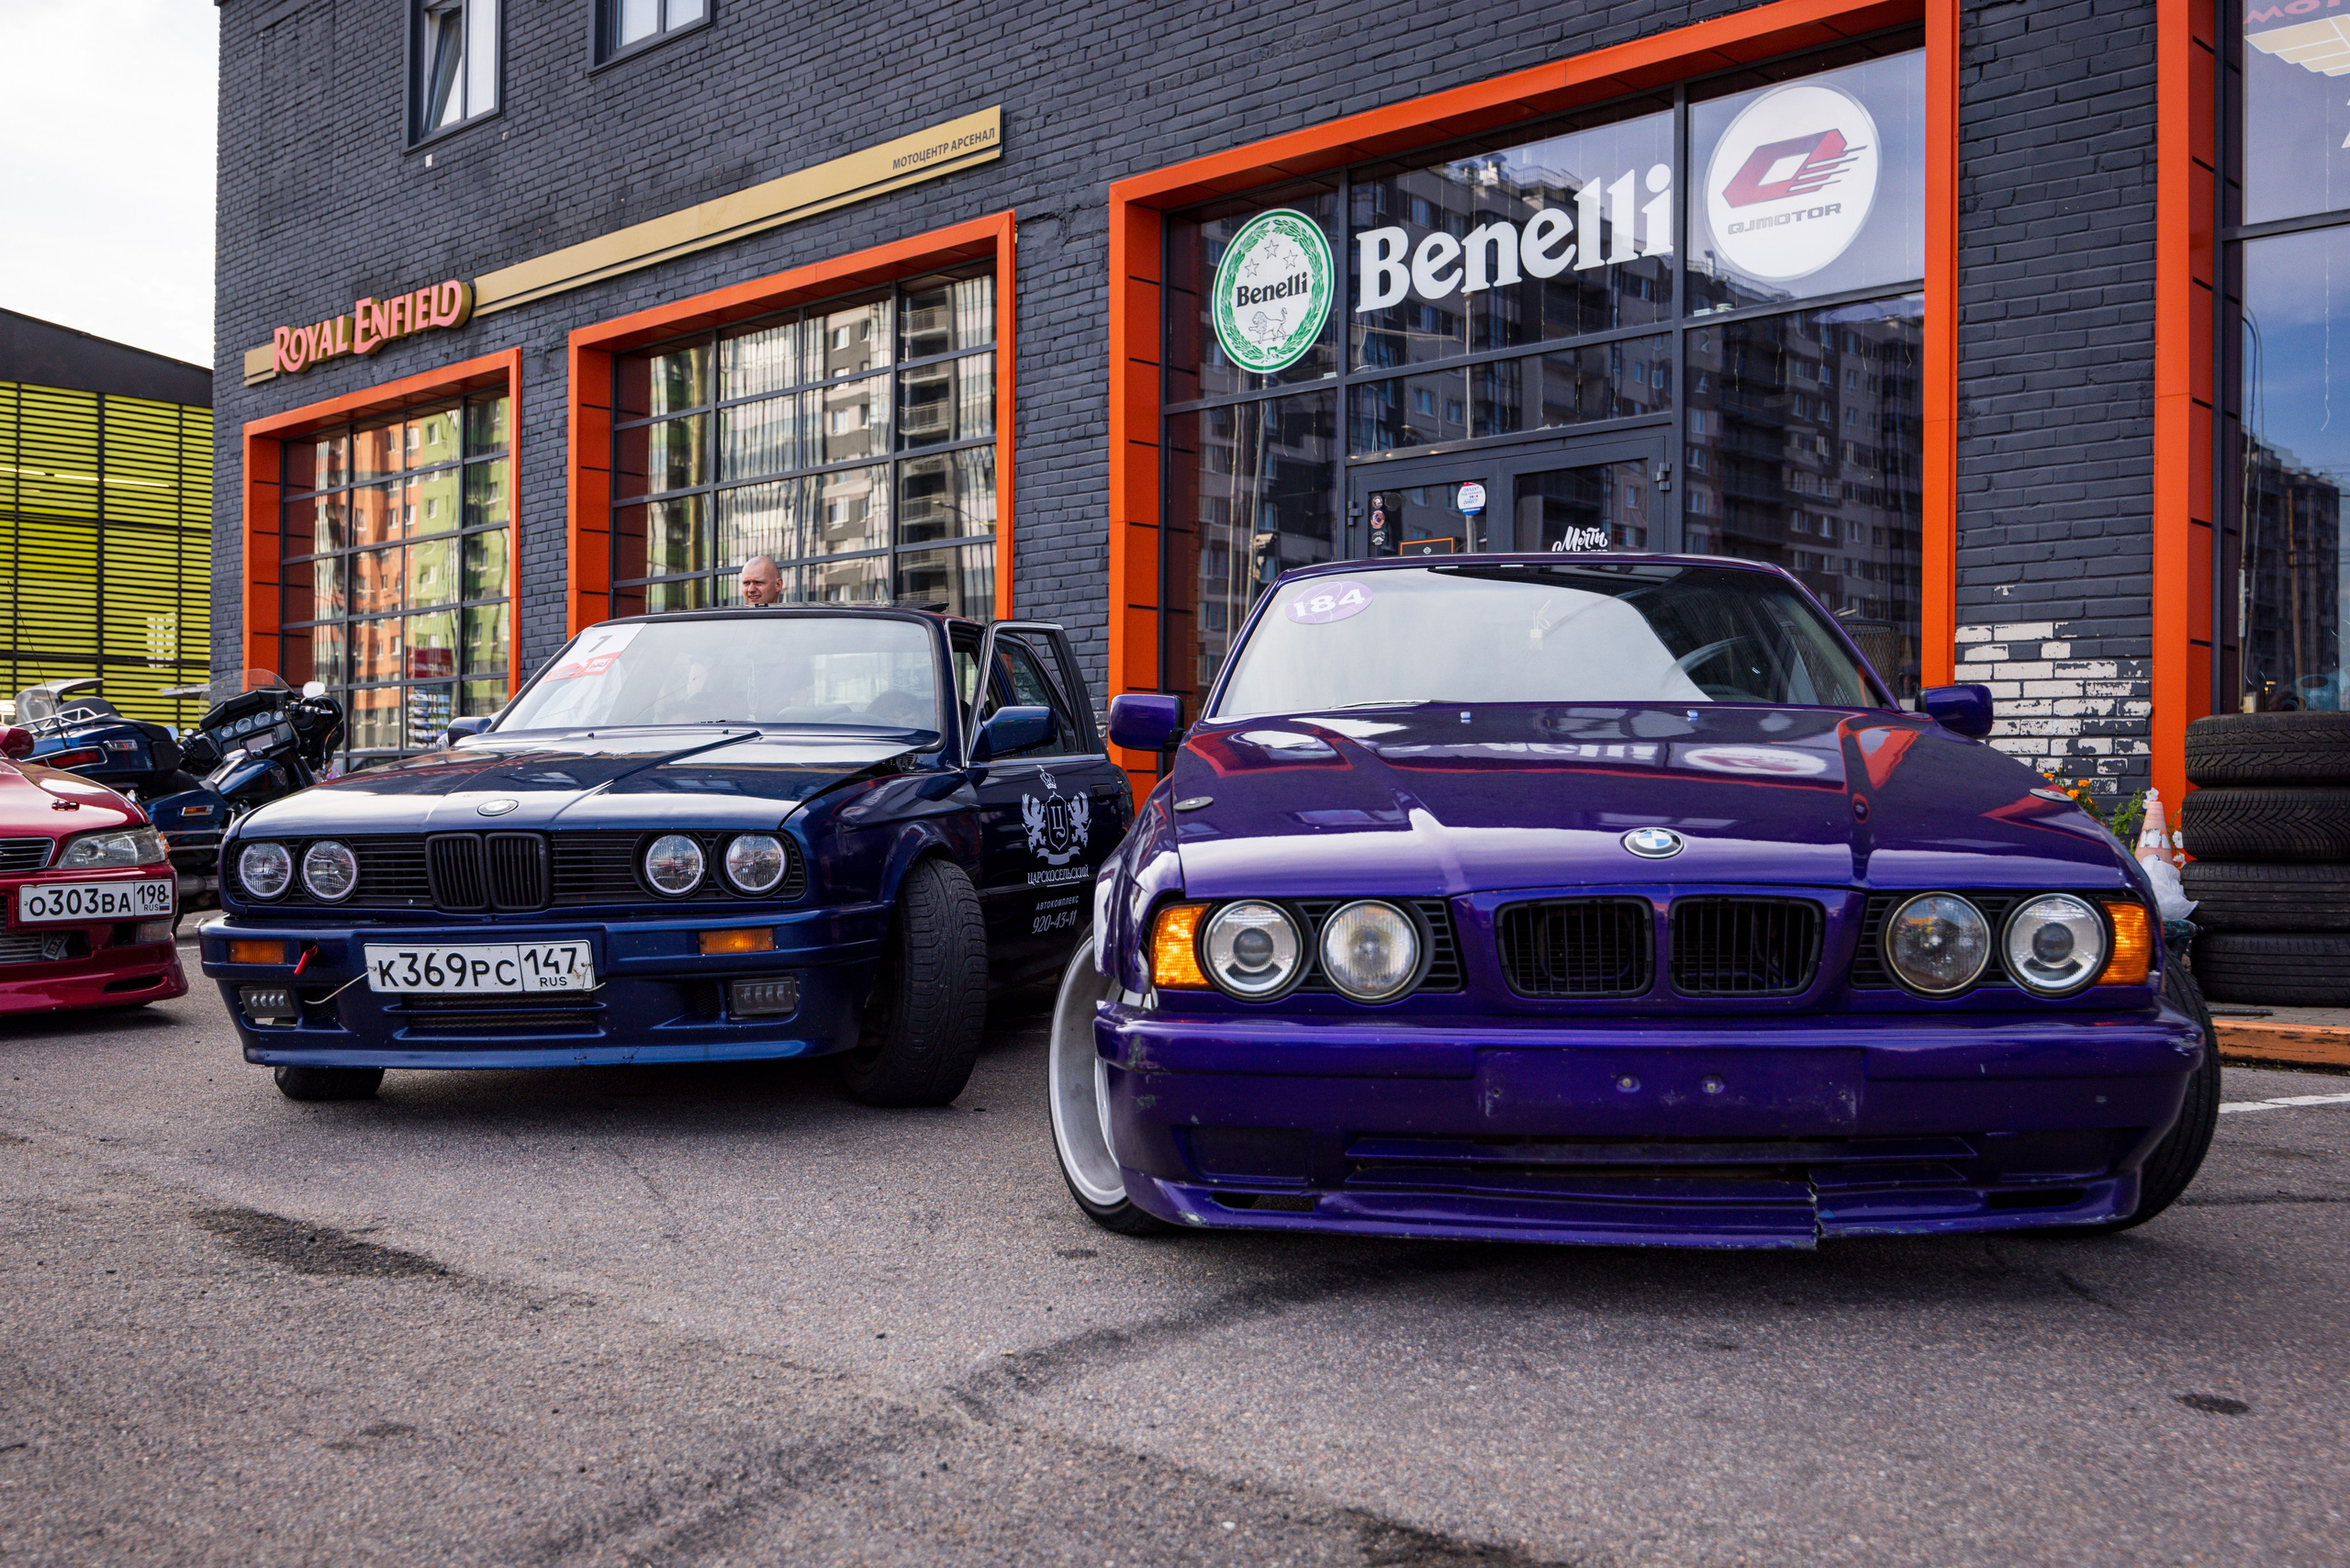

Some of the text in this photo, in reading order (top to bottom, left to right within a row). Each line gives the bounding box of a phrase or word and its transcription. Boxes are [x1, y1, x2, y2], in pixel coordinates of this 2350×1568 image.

[892, 128, 995, 170] МОТОЦЕНТР АРСЕНАЛ
[1728, 203, 1841, 235] QJMOTOR
[1355, 163, 1673, 313] Benelli
[1236, 271, 1308, 308] Benelli
[273, 279, 464, 373] ROYAL ENFIELD
[1292, 588, 1365, 618] 184
[1027, 864, 1090, 886] ЦАРСКОСЕЛЬСКИЙ
[28, 884, 166, 917] О303ВА 198
[143, 903, 159, 912] RUS
[1035, 896, 1080, 911] АВТОКОМПЛЕКС
[1031, 910, 1078, 935] 920-43-11
[377, 946, 577, 988] К369РС 147
[540, 977, 567, 987] RUS
